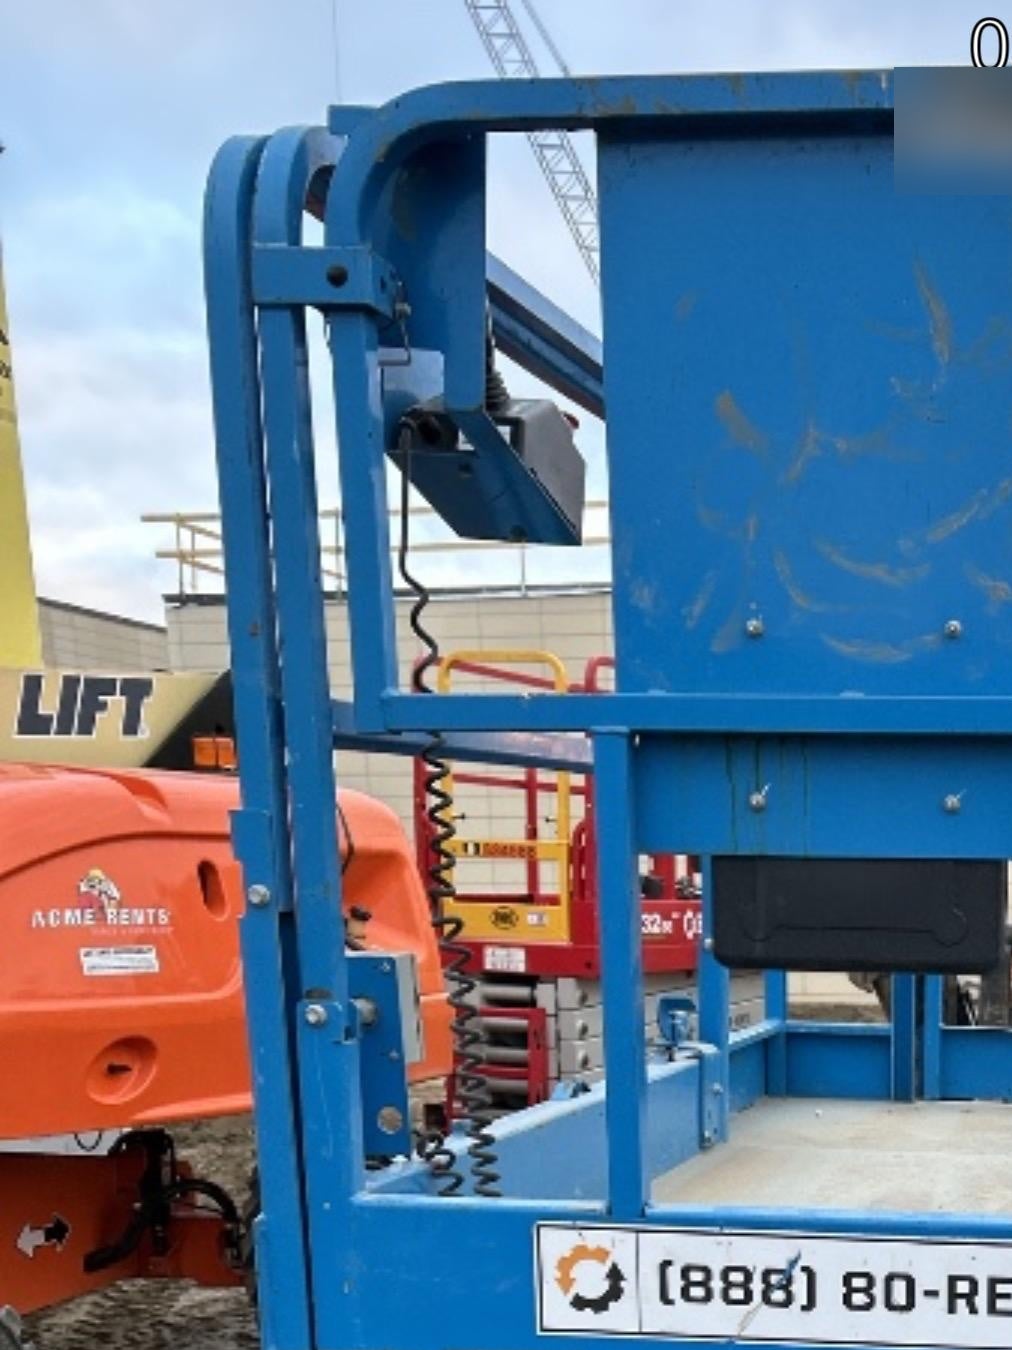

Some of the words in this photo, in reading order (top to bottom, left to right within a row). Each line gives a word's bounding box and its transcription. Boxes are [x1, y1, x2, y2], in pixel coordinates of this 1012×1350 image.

[16, 673, 154, 737] LIFT
[31, 908, 96, 929] ACME
[106, 907, 170, 925] RENTS
[659, 1258, 817, 1312] (888)
